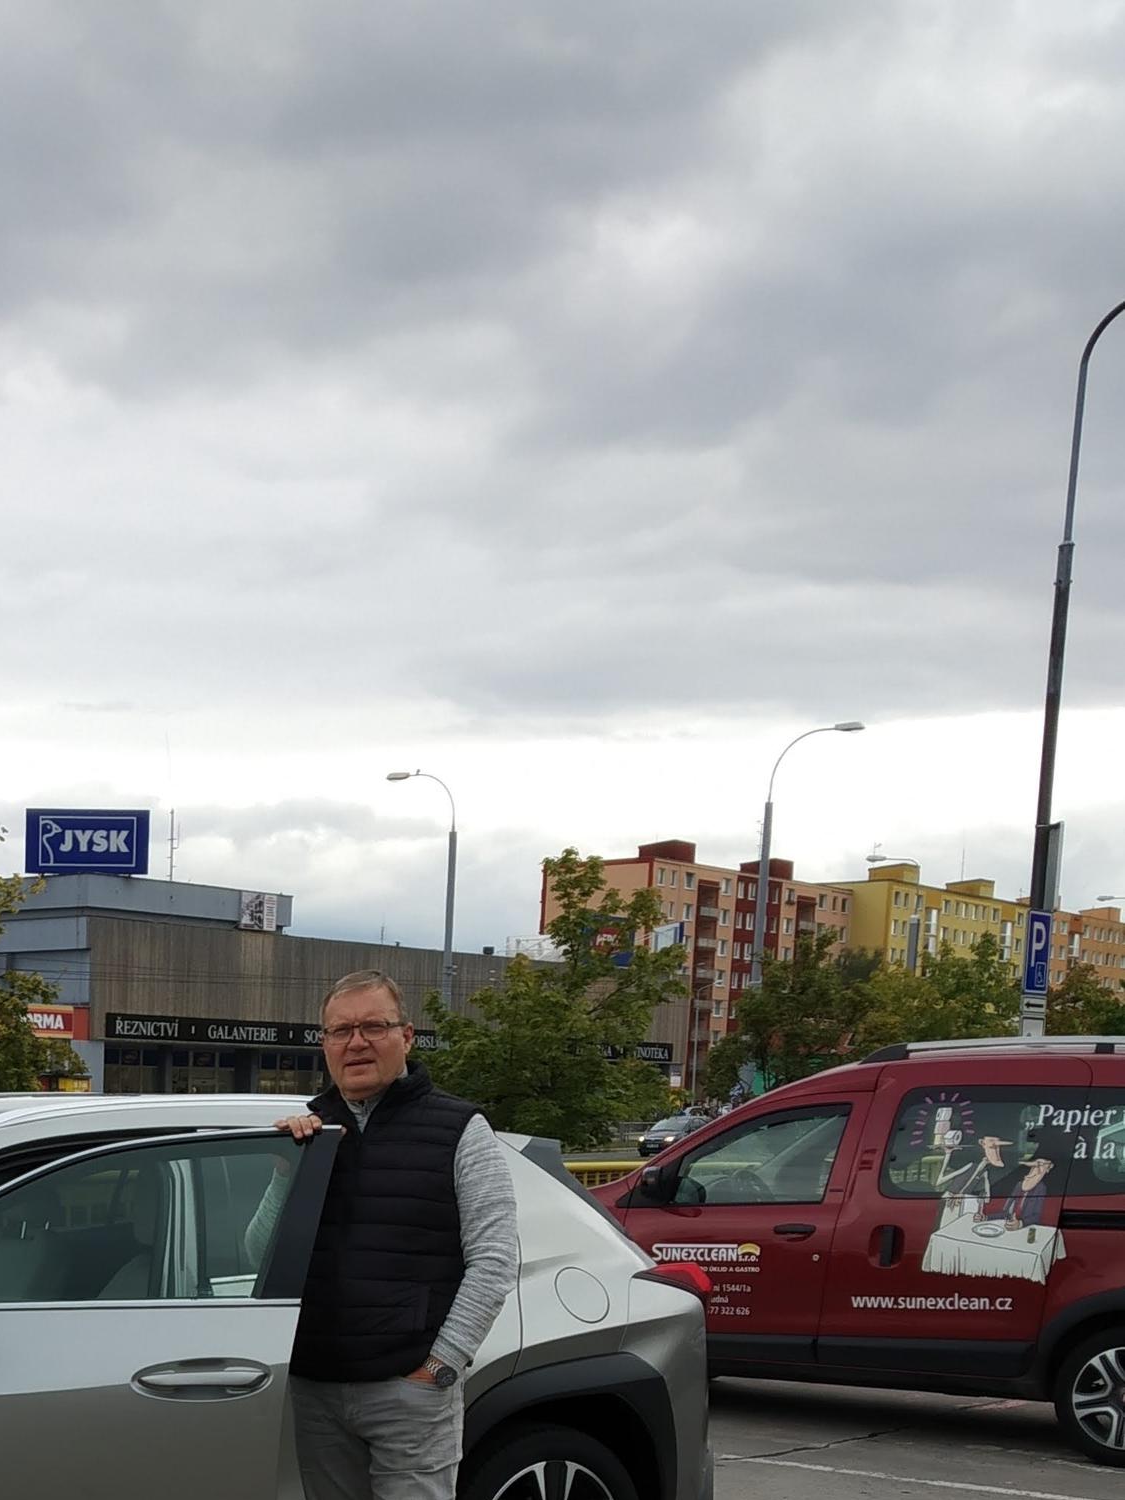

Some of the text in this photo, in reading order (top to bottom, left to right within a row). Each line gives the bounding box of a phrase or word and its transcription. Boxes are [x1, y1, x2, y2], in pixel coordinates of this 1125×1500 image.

[59, 830, 130, 853] JYSK
[1030, 921, 1047, 967] P
[115, 1015, 179, 1036] ŘEZNICTVÍ
[207, 1024, 278, 1042] GALANTERIE
[1073, 1135, 1088, 1159] à
[1092, 1135, 1116, 1159] la
[722, 1283, 751, 1293] 1544/1a
[721, 1306, 734, 1315] 322
[736, 1306, 751, 1316] 626
[851, 1292, 1013, 1311] www.sunexclean.cz
